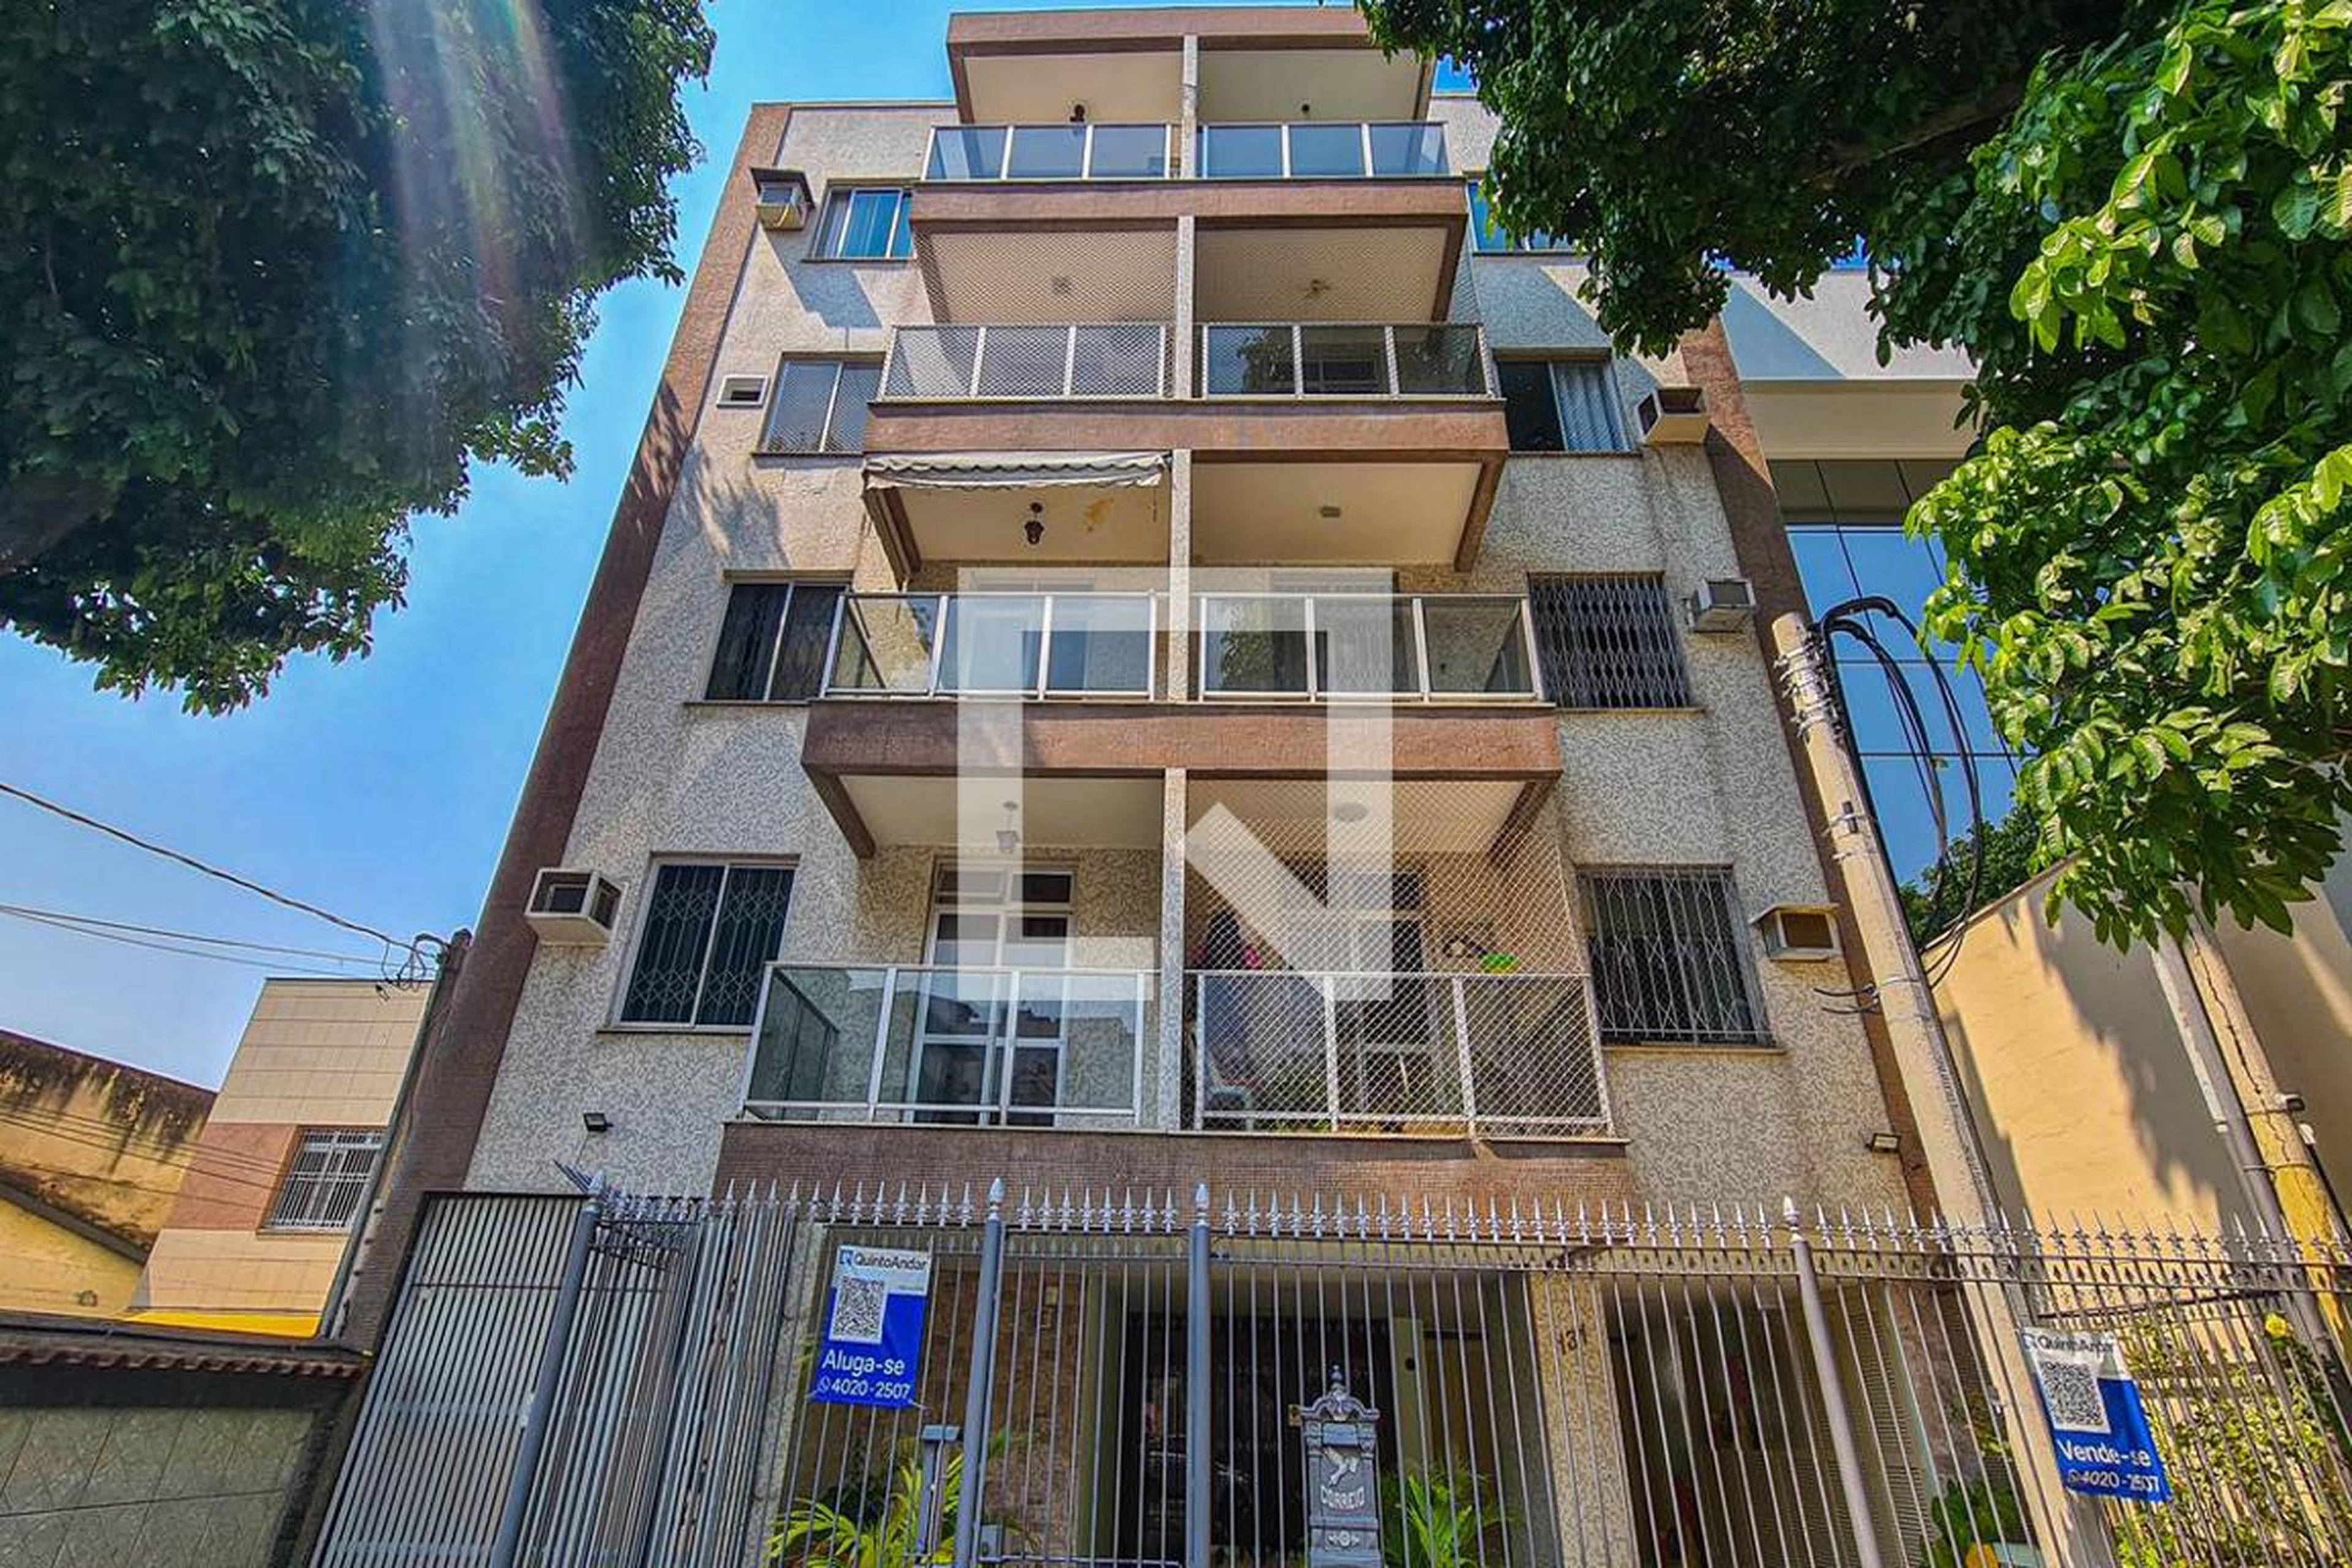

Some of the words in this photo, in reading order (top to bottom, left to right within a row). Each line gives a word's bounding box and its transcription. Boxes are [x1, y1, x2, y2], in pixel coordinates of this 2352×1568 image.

[855, 1253, 927, 1270] QuintoAndar
[823, 1349, 905, 1376] Aluga-se
[2056, 1439, 2151, 1467] Vende-se
